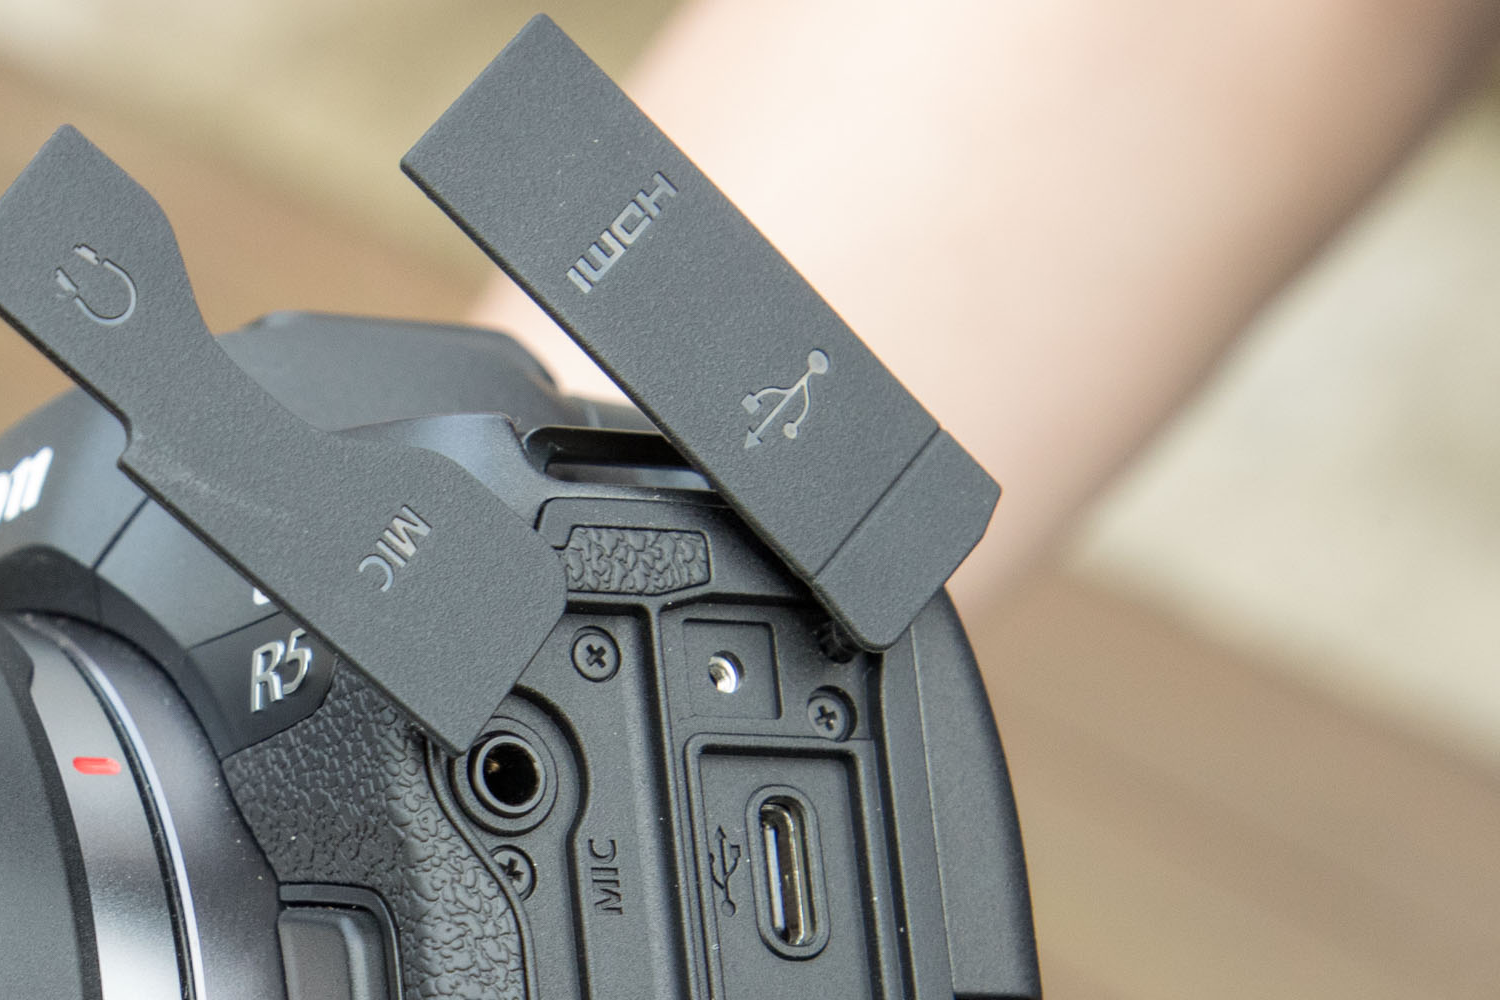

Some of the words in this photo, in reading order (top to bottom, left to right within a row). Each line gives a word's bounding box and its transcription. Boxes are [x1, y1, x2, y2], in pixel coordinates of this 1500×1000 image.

[566, 171, 679, 294] HDMI
[358, 504, 433, 592] MIC
[251, 627, 313, 712] R5
[588, 838, 623, 916] MIC
